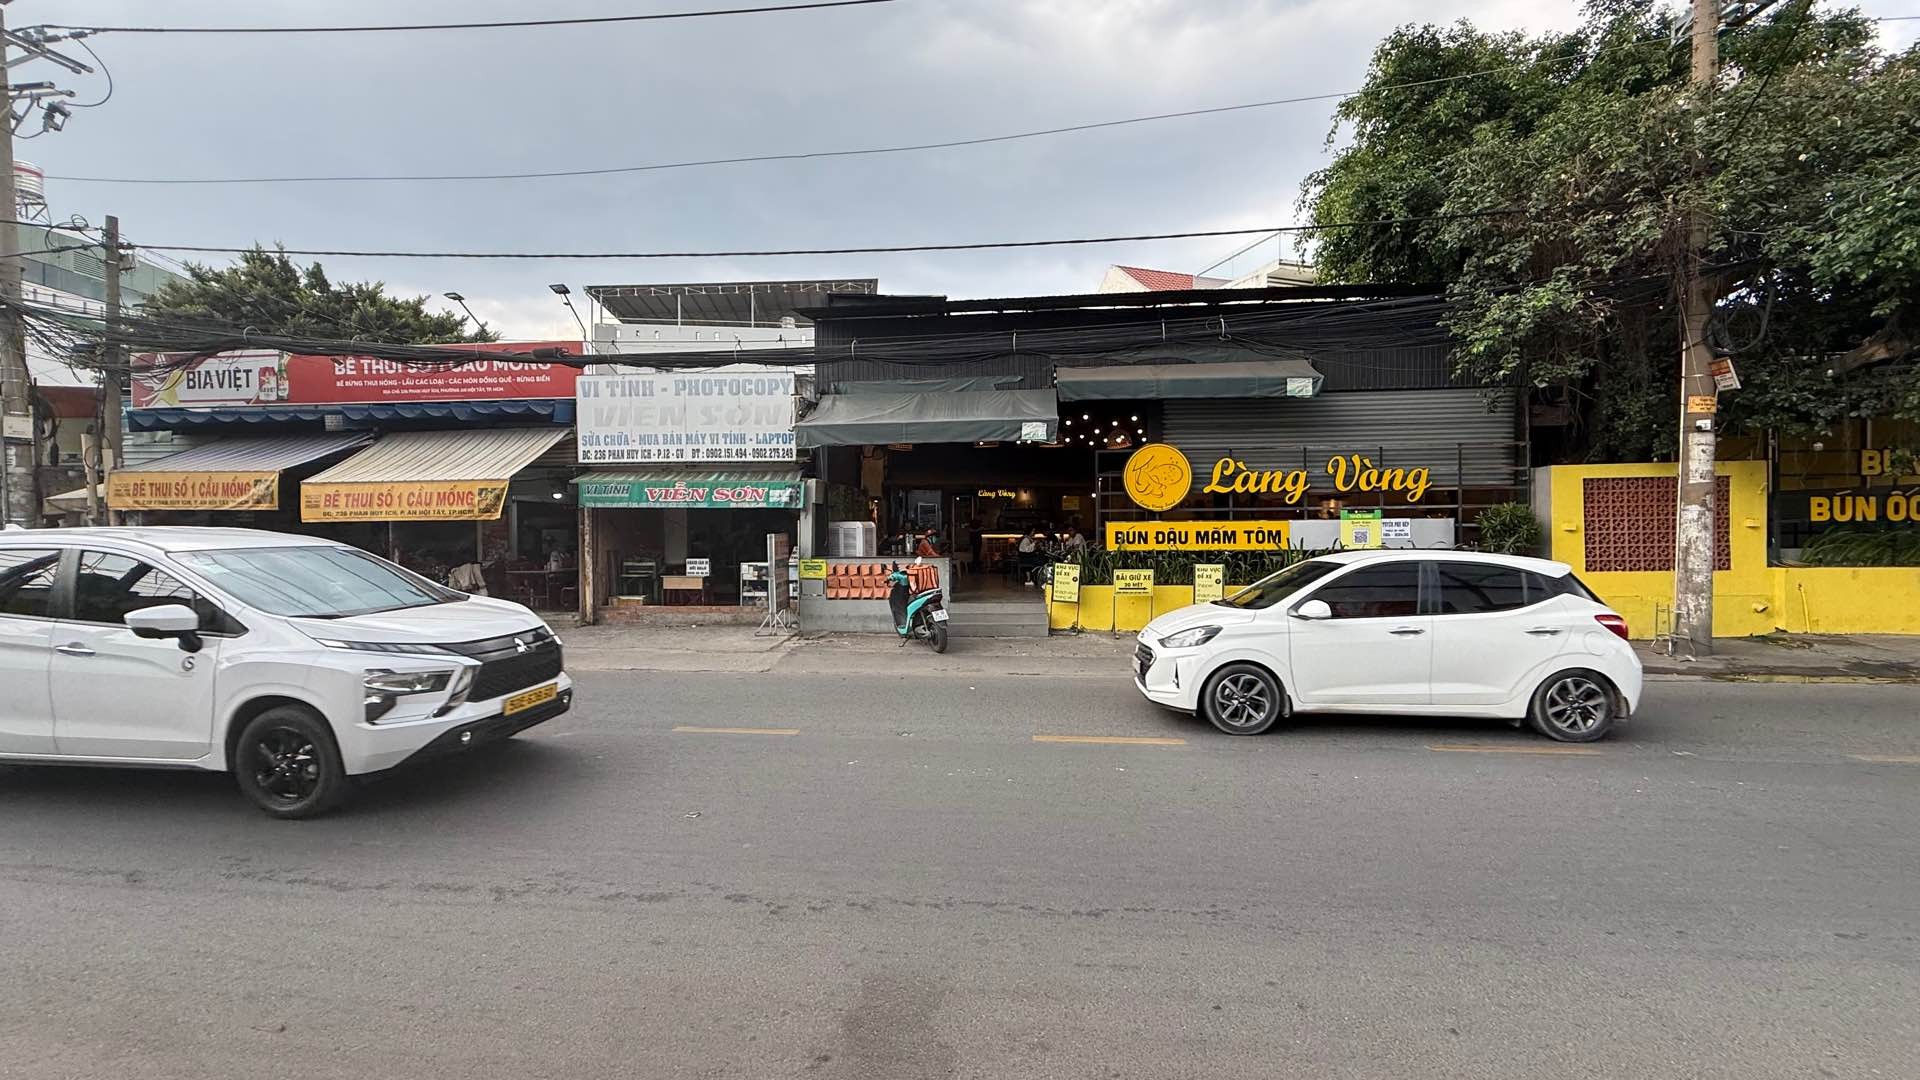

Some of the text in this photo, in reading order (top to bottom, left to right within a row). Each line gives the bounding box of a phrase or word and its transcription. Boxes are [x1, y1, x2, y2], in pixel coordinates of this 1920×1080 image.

[360, 360, 402, 374] THUI
[415, 377, 428, 385] CÁC
[449, 376, 461, 384] CÁC
[580, 381, 600, 398] VI
[673, 378, 792, 397] PHOTOCOPY
[638, 434, 659, 446] MUA
[662, 430, 682, 445] BÁN
[685, 430, 707, 445] MÁY
[709, 433, 719, 445] VI
[721, 430, 746, 445] TÍNH
[755, 433, 794, 445] LAPTOP
[608, 449, 625, 460] PHAN
[626, 449, 639, 460] HUY
[131, 479, 146, 497] BÊ
[149, 482, 171, 497] THUI
[174, 476, 189, 497] SỐ
[191, 482, 196, 497] 1
[199, 475, 219, 497] CẦU
[221, 476, 250, 497] MỐNG
[1202, 453, 1433, 504] Làng Vòng
[324, 489, 341, 508] BÊ
[344, 492, 373, 508] THUI
[376, 486, 394, 507] SỐ
[397, 492, 402, 507] 1
[407, 485, 433, 507] CẦU
[435, 485, 475, 506] MỐNG
[585, 485, 598, 495] VI
[645, 481, 708, 502] VIỄN
[713, 485, 768, 502] SƠN
[1810, 490, 1877, 522] BÚN
[1114, 525, 1282, 547] BÚN ĐẬU MẮM TÔM
[1129, 573, 1142, 581] GIỮ
